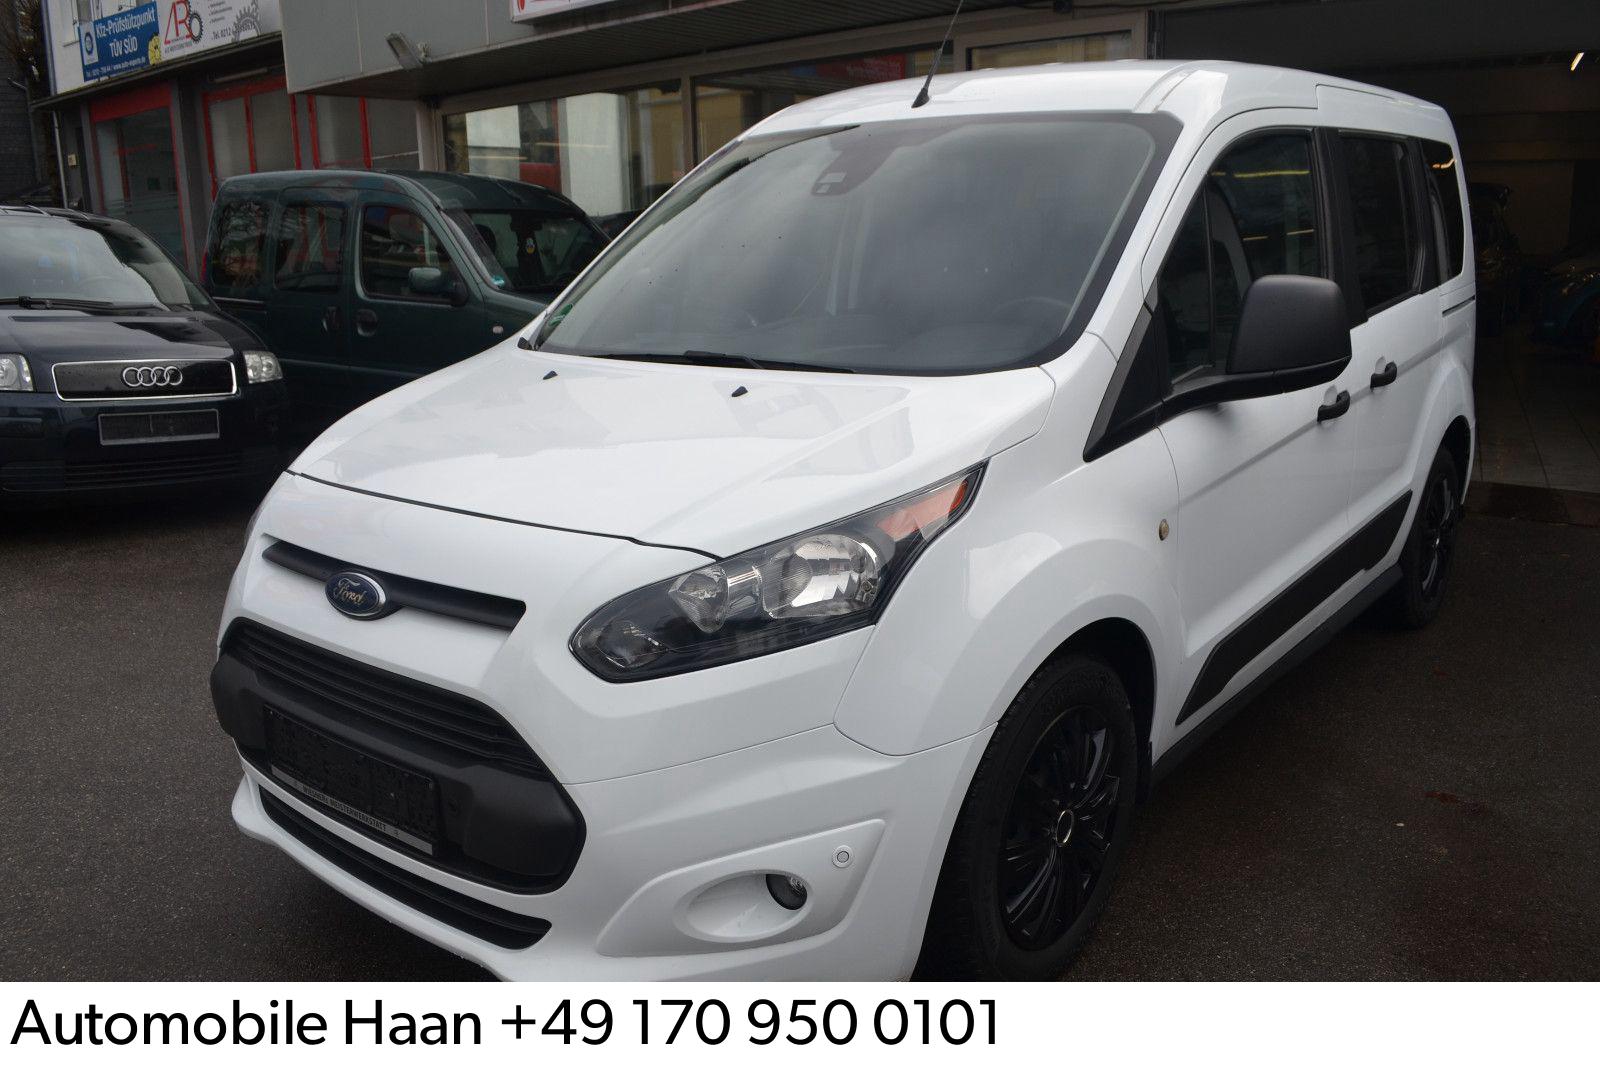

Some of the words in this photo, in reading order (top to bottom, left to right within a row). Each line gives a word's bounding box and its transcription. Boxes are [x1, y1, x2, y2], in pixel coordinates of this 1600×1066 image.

[95, 7, 156, 39] Kfz-Prüfstützpunkt
[109, 39, 123, 58] TÜV
[123, 34, 138, 55] SÜD
